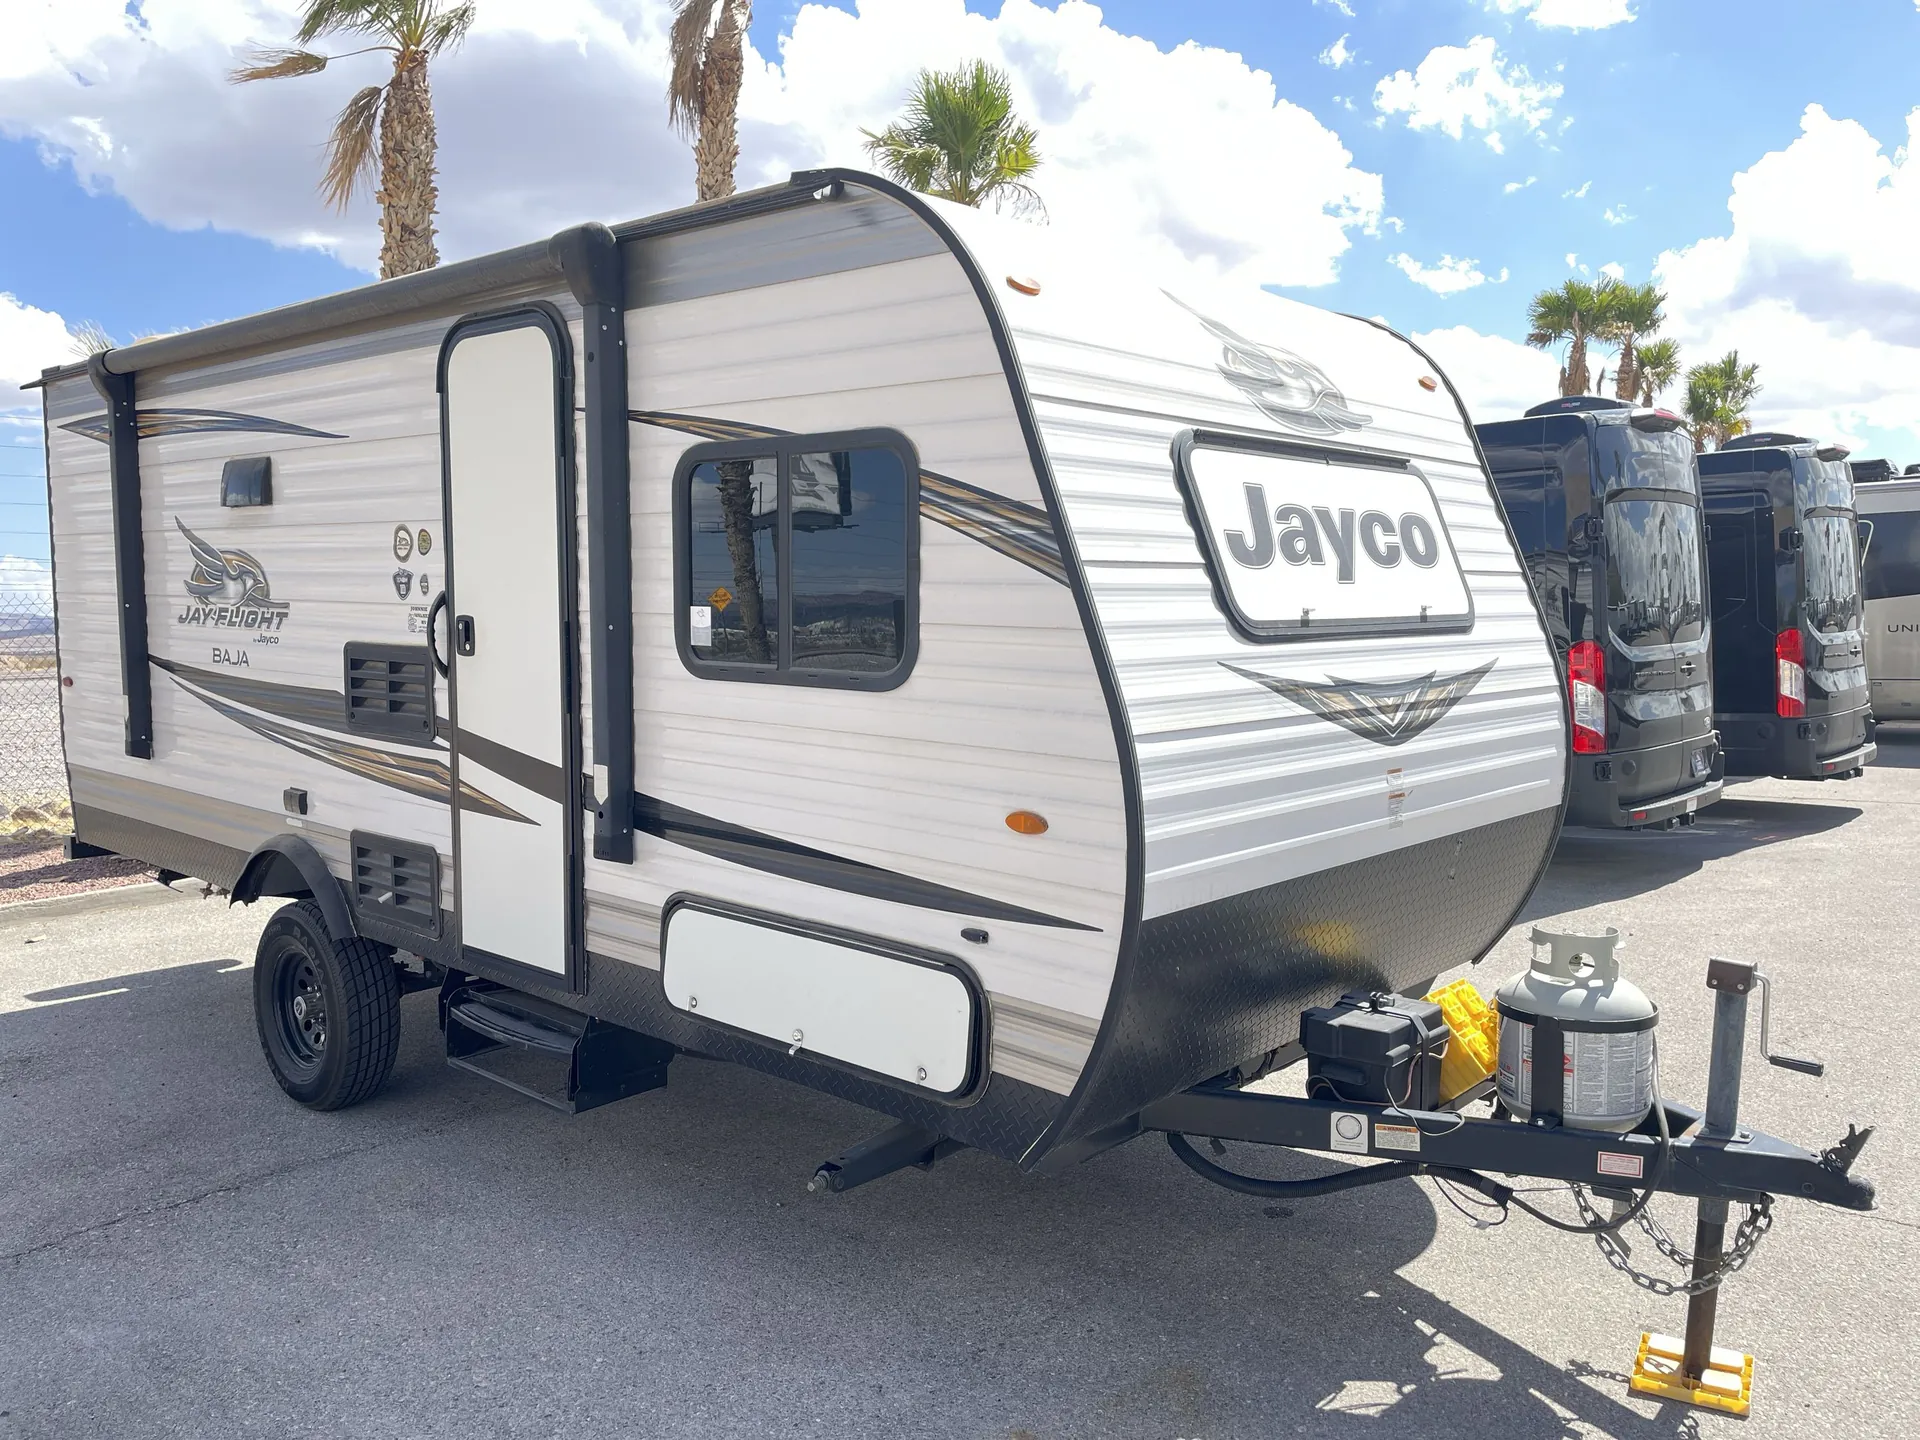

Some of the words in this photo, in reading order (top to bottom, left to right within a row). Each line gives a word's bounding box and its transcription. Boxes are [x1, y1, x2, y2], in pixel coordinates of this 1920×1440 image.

[1223, 481, 1439, 584] Jayco
[257, 633, 280, 646] Jayco
[212, 647, 250, 667] BAJA
